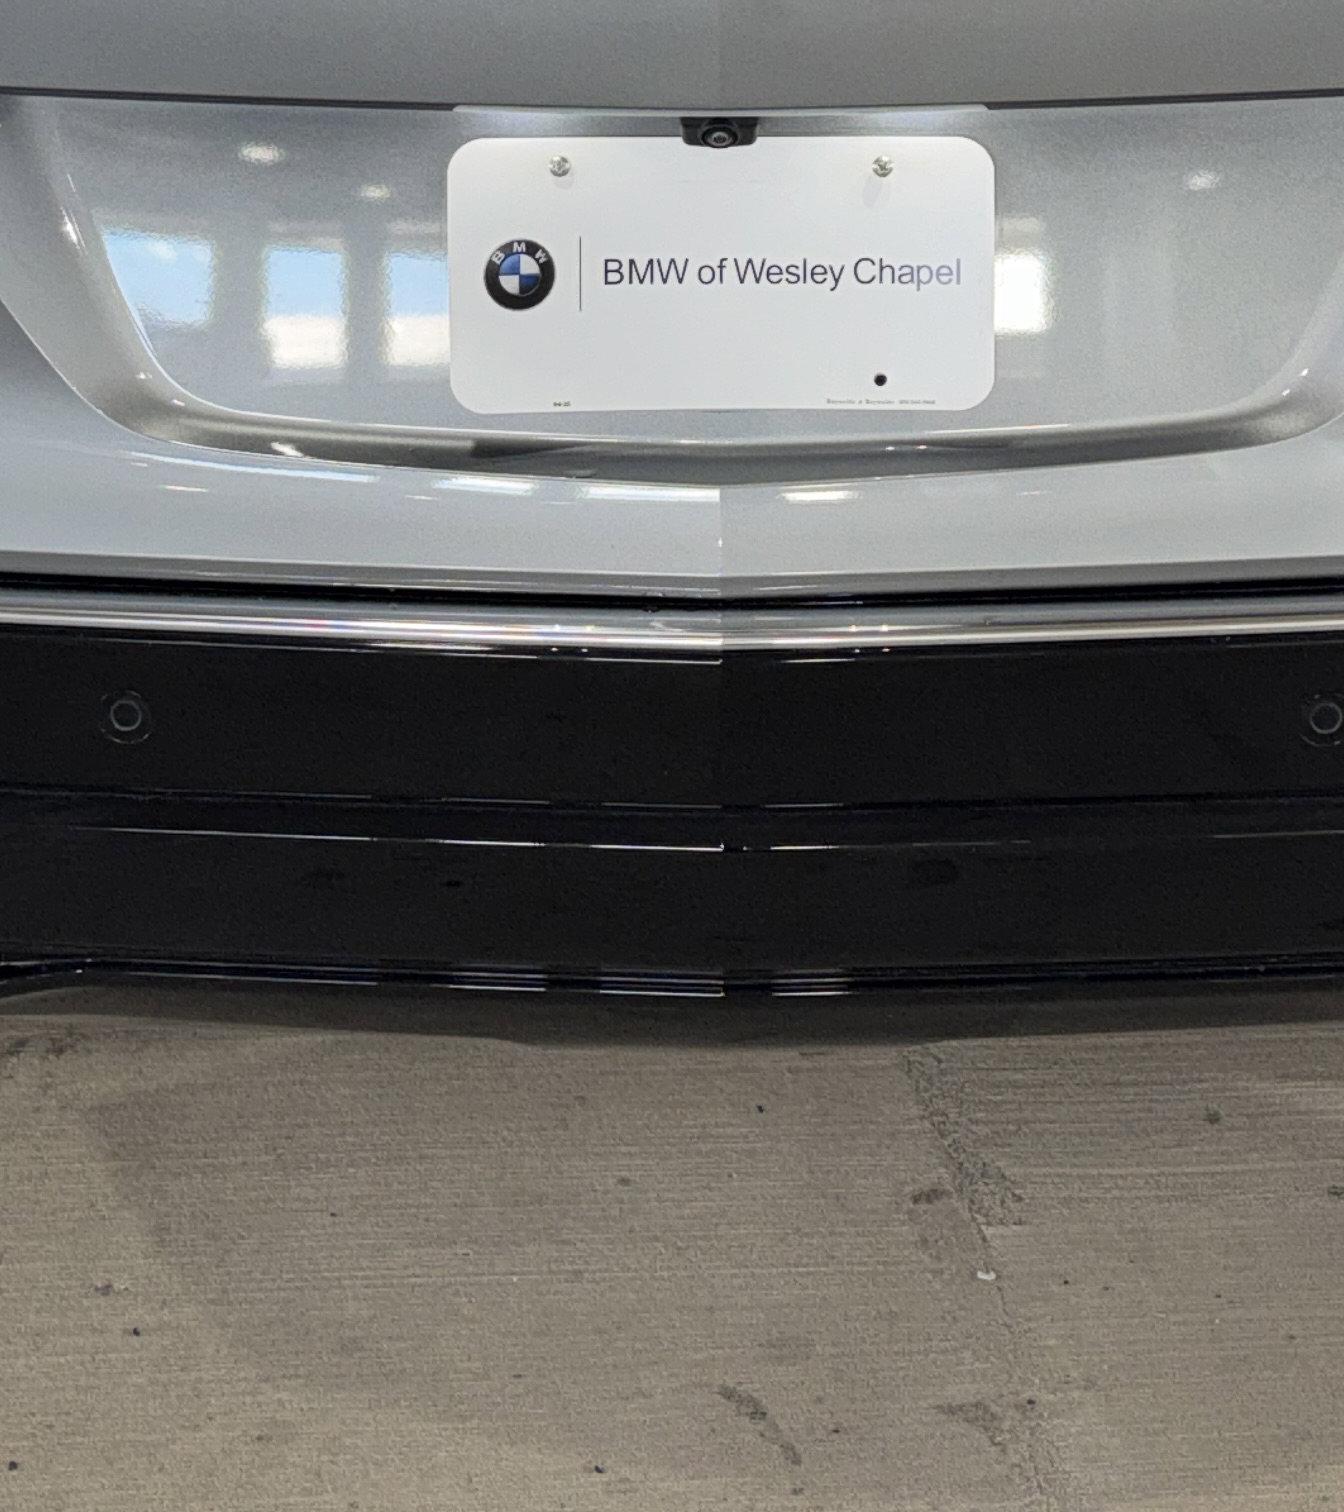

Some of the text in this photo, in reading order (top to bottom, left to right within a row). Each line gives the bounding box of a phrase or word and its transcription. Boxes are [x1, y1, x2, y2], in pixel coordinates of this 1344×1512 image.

[491, 241, 548, 265] BMW
[604, 257, 961, 292] BMW of Wesley Chapel
